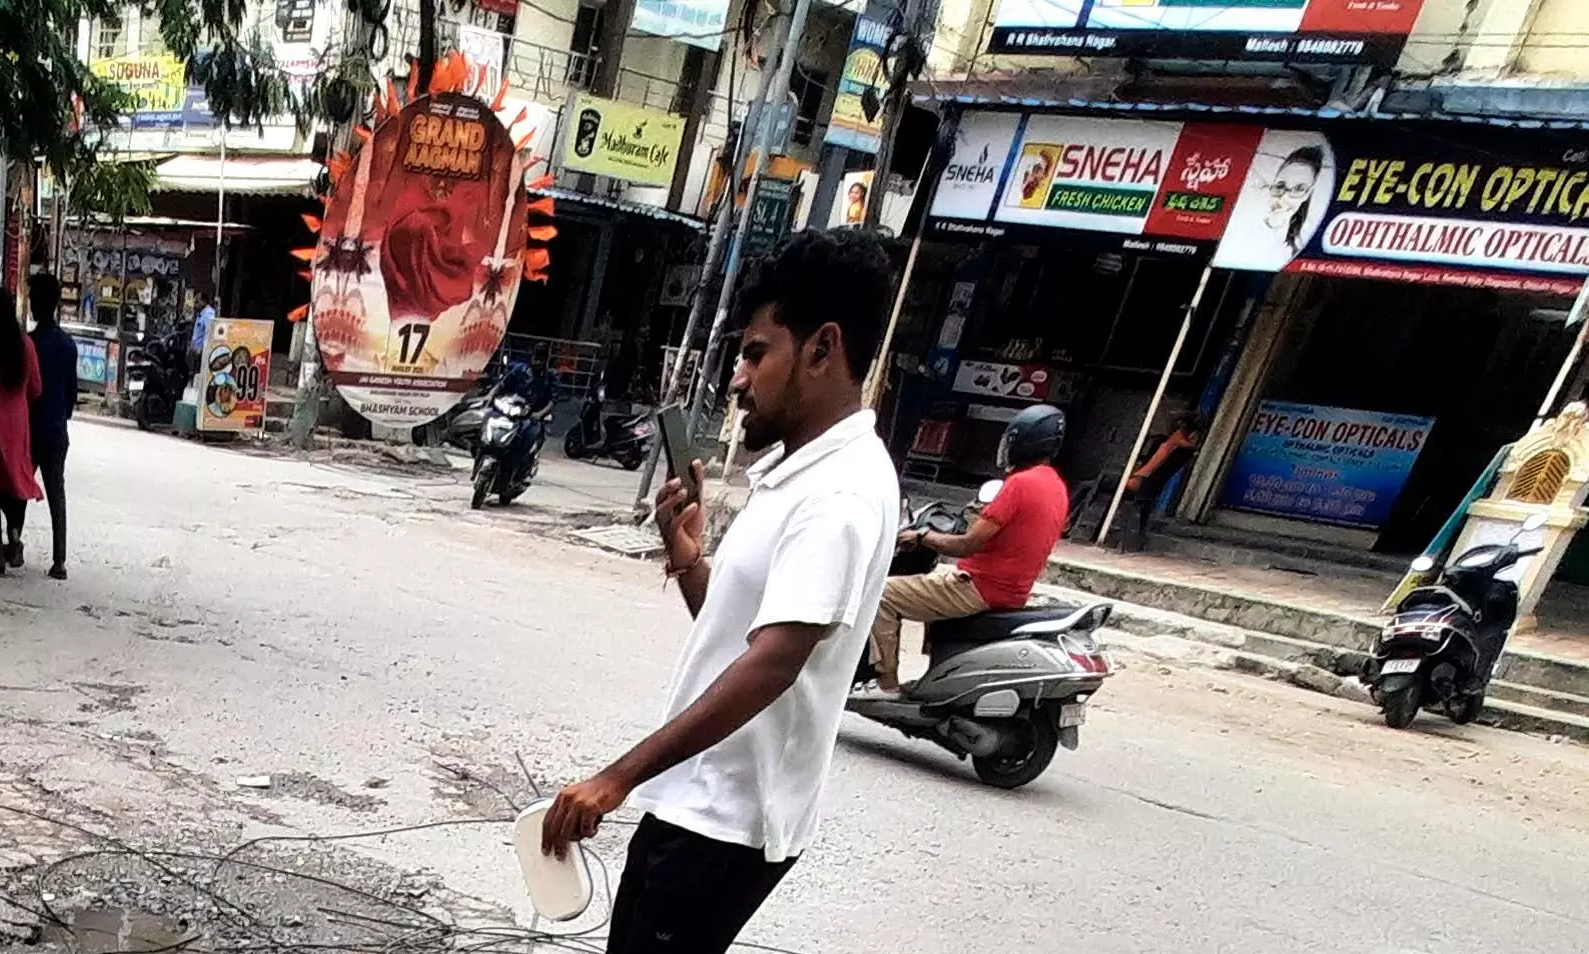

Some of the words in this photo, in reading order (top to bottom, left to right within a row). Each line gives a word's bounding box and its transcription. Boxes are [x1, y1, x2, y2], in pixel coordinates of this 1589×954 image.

[410, 114, 486, 152] GRAND
[945, 164, 995, 183] SNEHA
[1056, 144, 1162, 185] SNEHA
[1336, 158, 1481, 208] EYE-CON
[1051, 190, 1091, 206] FRESH
[1091, 194, 1147, 213] CHICKEN
[1329, 217, 1484, 257] OPHTHALMIC
[1484, 228, 1589, 266] OPTICAL
[398, 323, 431, 364] 17
[236, 364, 259, 401] 99
[361, 403, 408, 416] BHASHYAM
[408, 406, 440, 416] SCHOOL
[1252, 412, 1331, 441] EYE-CON
[1332, 421, 1424, 450] OPTICALS
